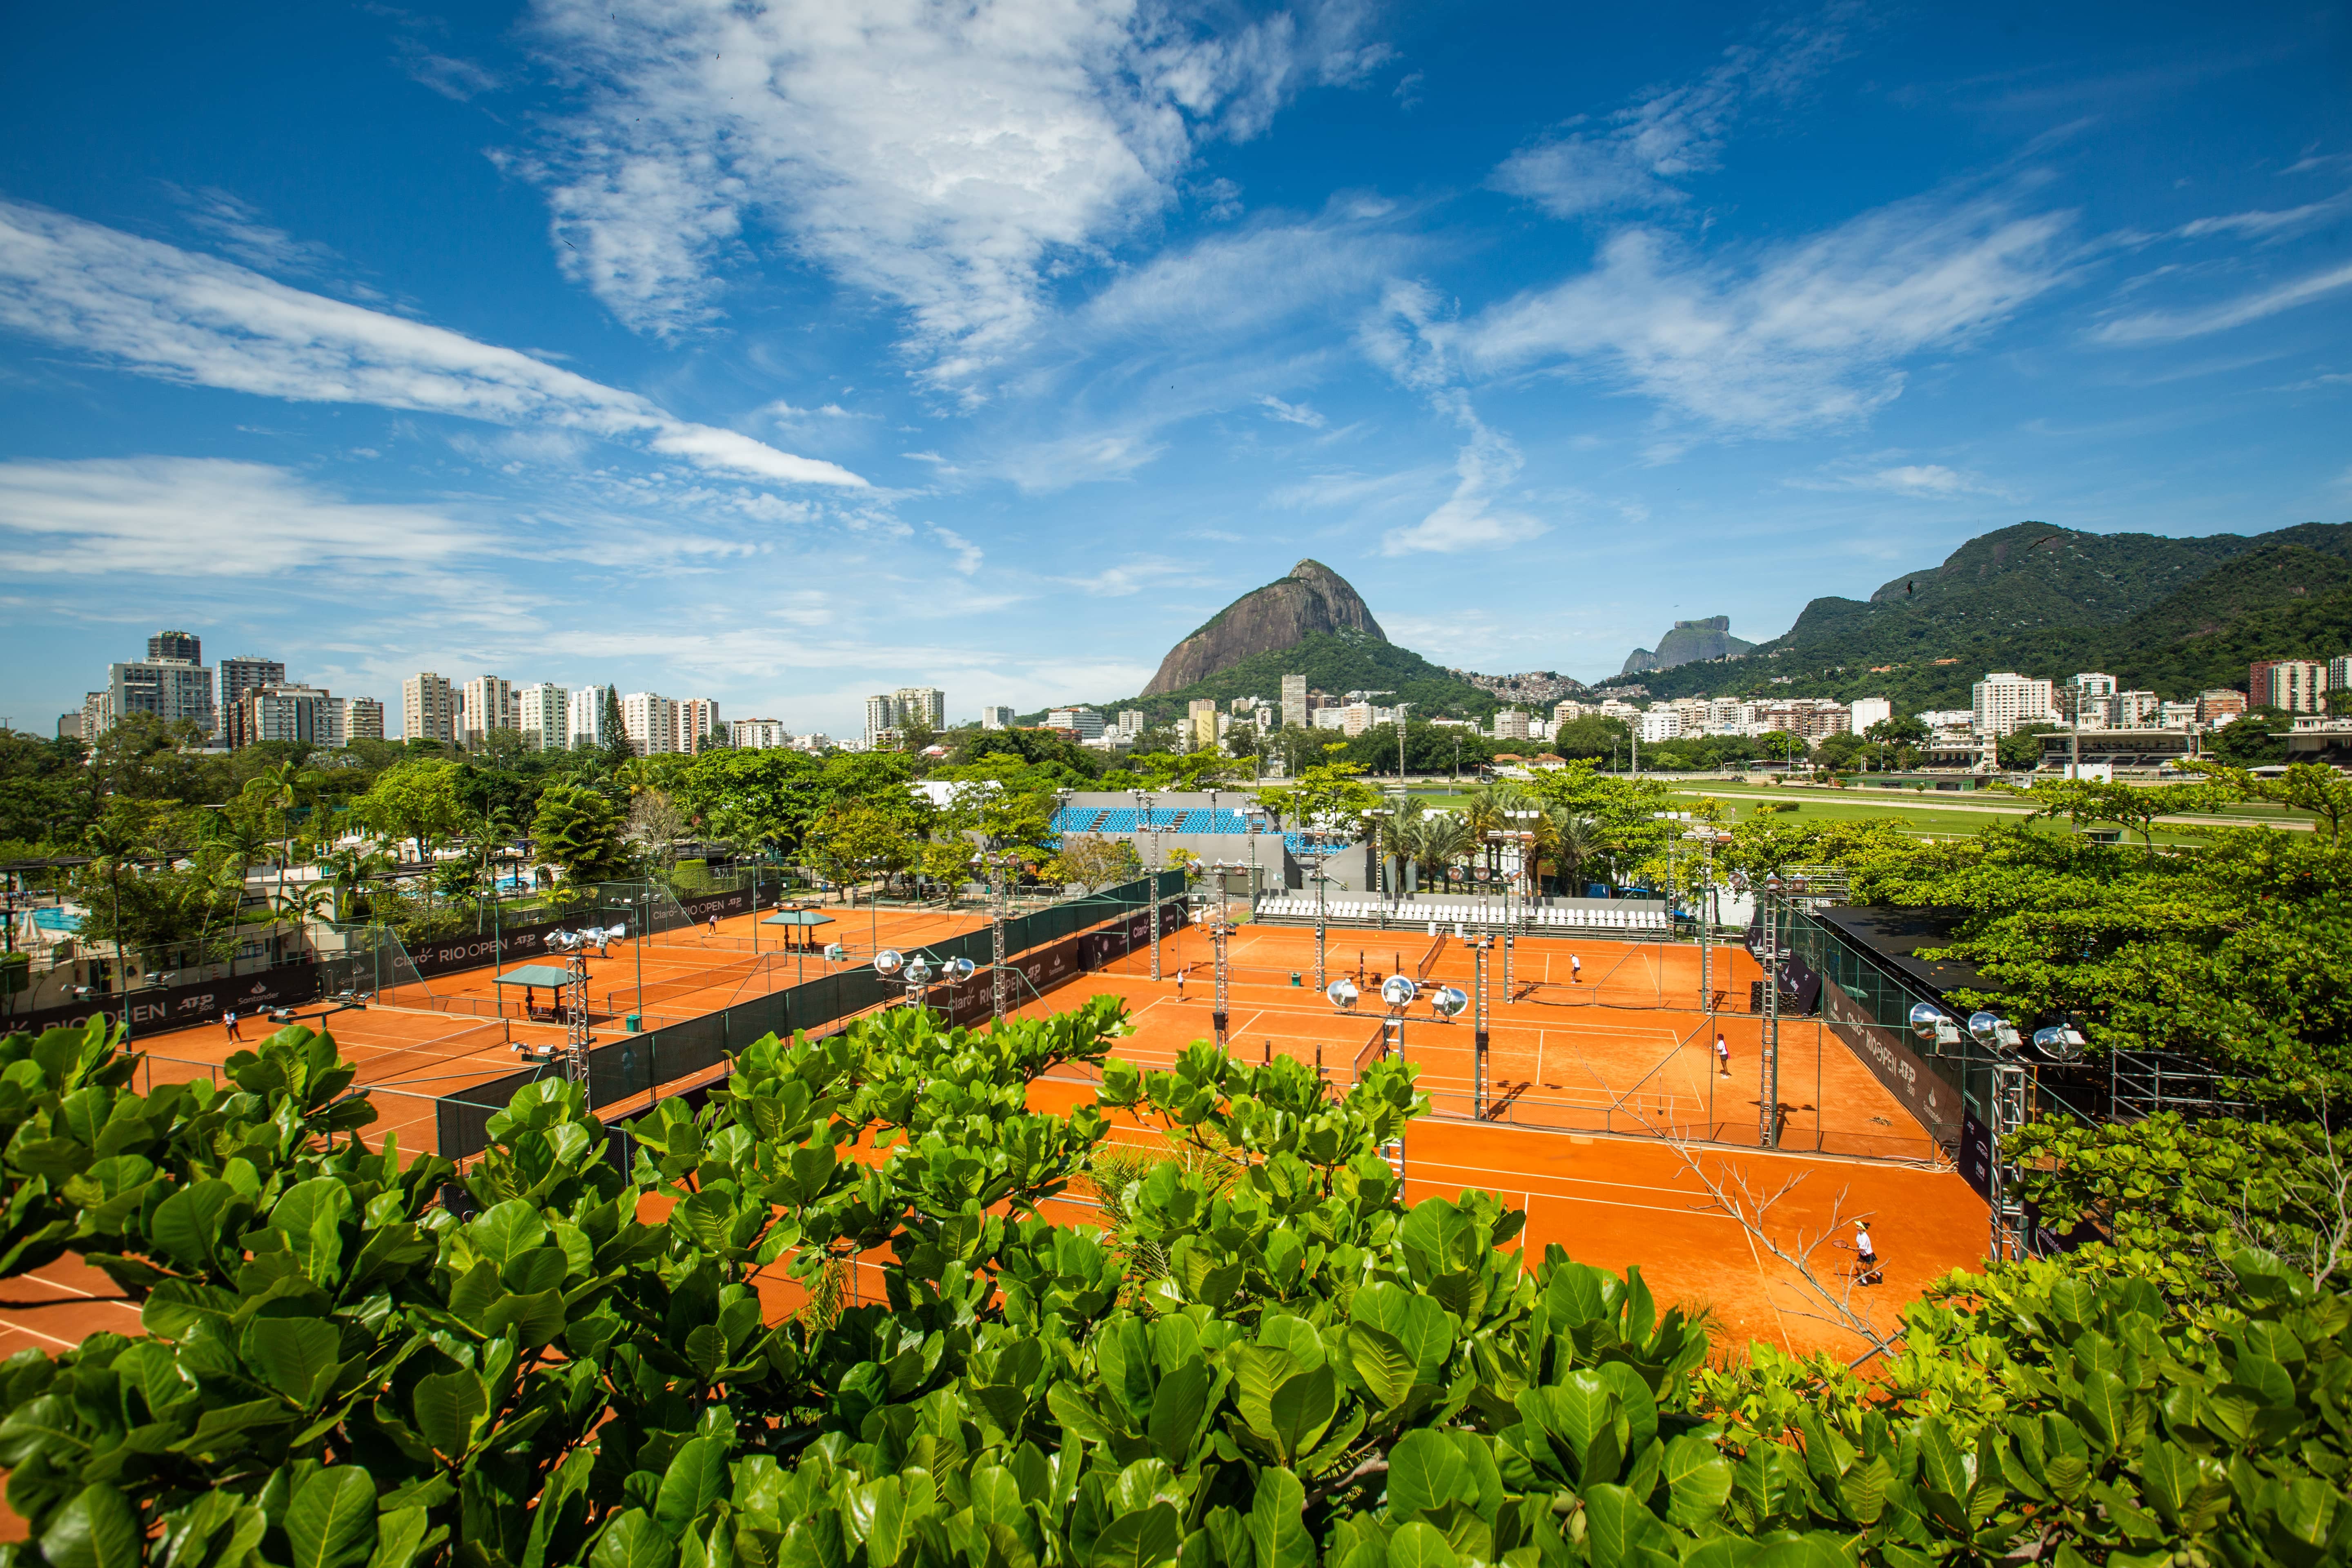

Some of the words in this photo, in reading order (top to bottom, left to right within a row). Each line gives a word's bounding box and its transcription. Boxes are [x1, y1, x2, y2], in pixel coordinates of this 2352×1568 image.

[682, 905, 697, 917] RIO
[699, 900, 724, 913] OPEN
[728, 897, 741, 906] ATP
[1133, 922, 1148, 938] Claro
[514, 934, 535, 945] ATP
[439, 946, 466, 962] RIO
[468, 938, 508, 956] OPEN
[394, 951, 429, 967] Claro
[1027, 964, 1040, 980] ATP
[177, 993, 214, 1010] ATP
[238, 992, 280, 1005] Santander
[948, 991, 973, 1012] Claro
[199, 1003, 215, 1012] 500
[1866, 1029, 1877, 1056] RIO
[1876, 1042, 1896, 1076] OPEN
[1898, 1060, 1916, 1083] ATP
[1907, 1083, 1915, 1097] 500
[1923, 1100, 1943, 1124] Santander
[1976, 1161, 1985, 1177] HDI
[2038, 1224, 2064, 1256] Santande
